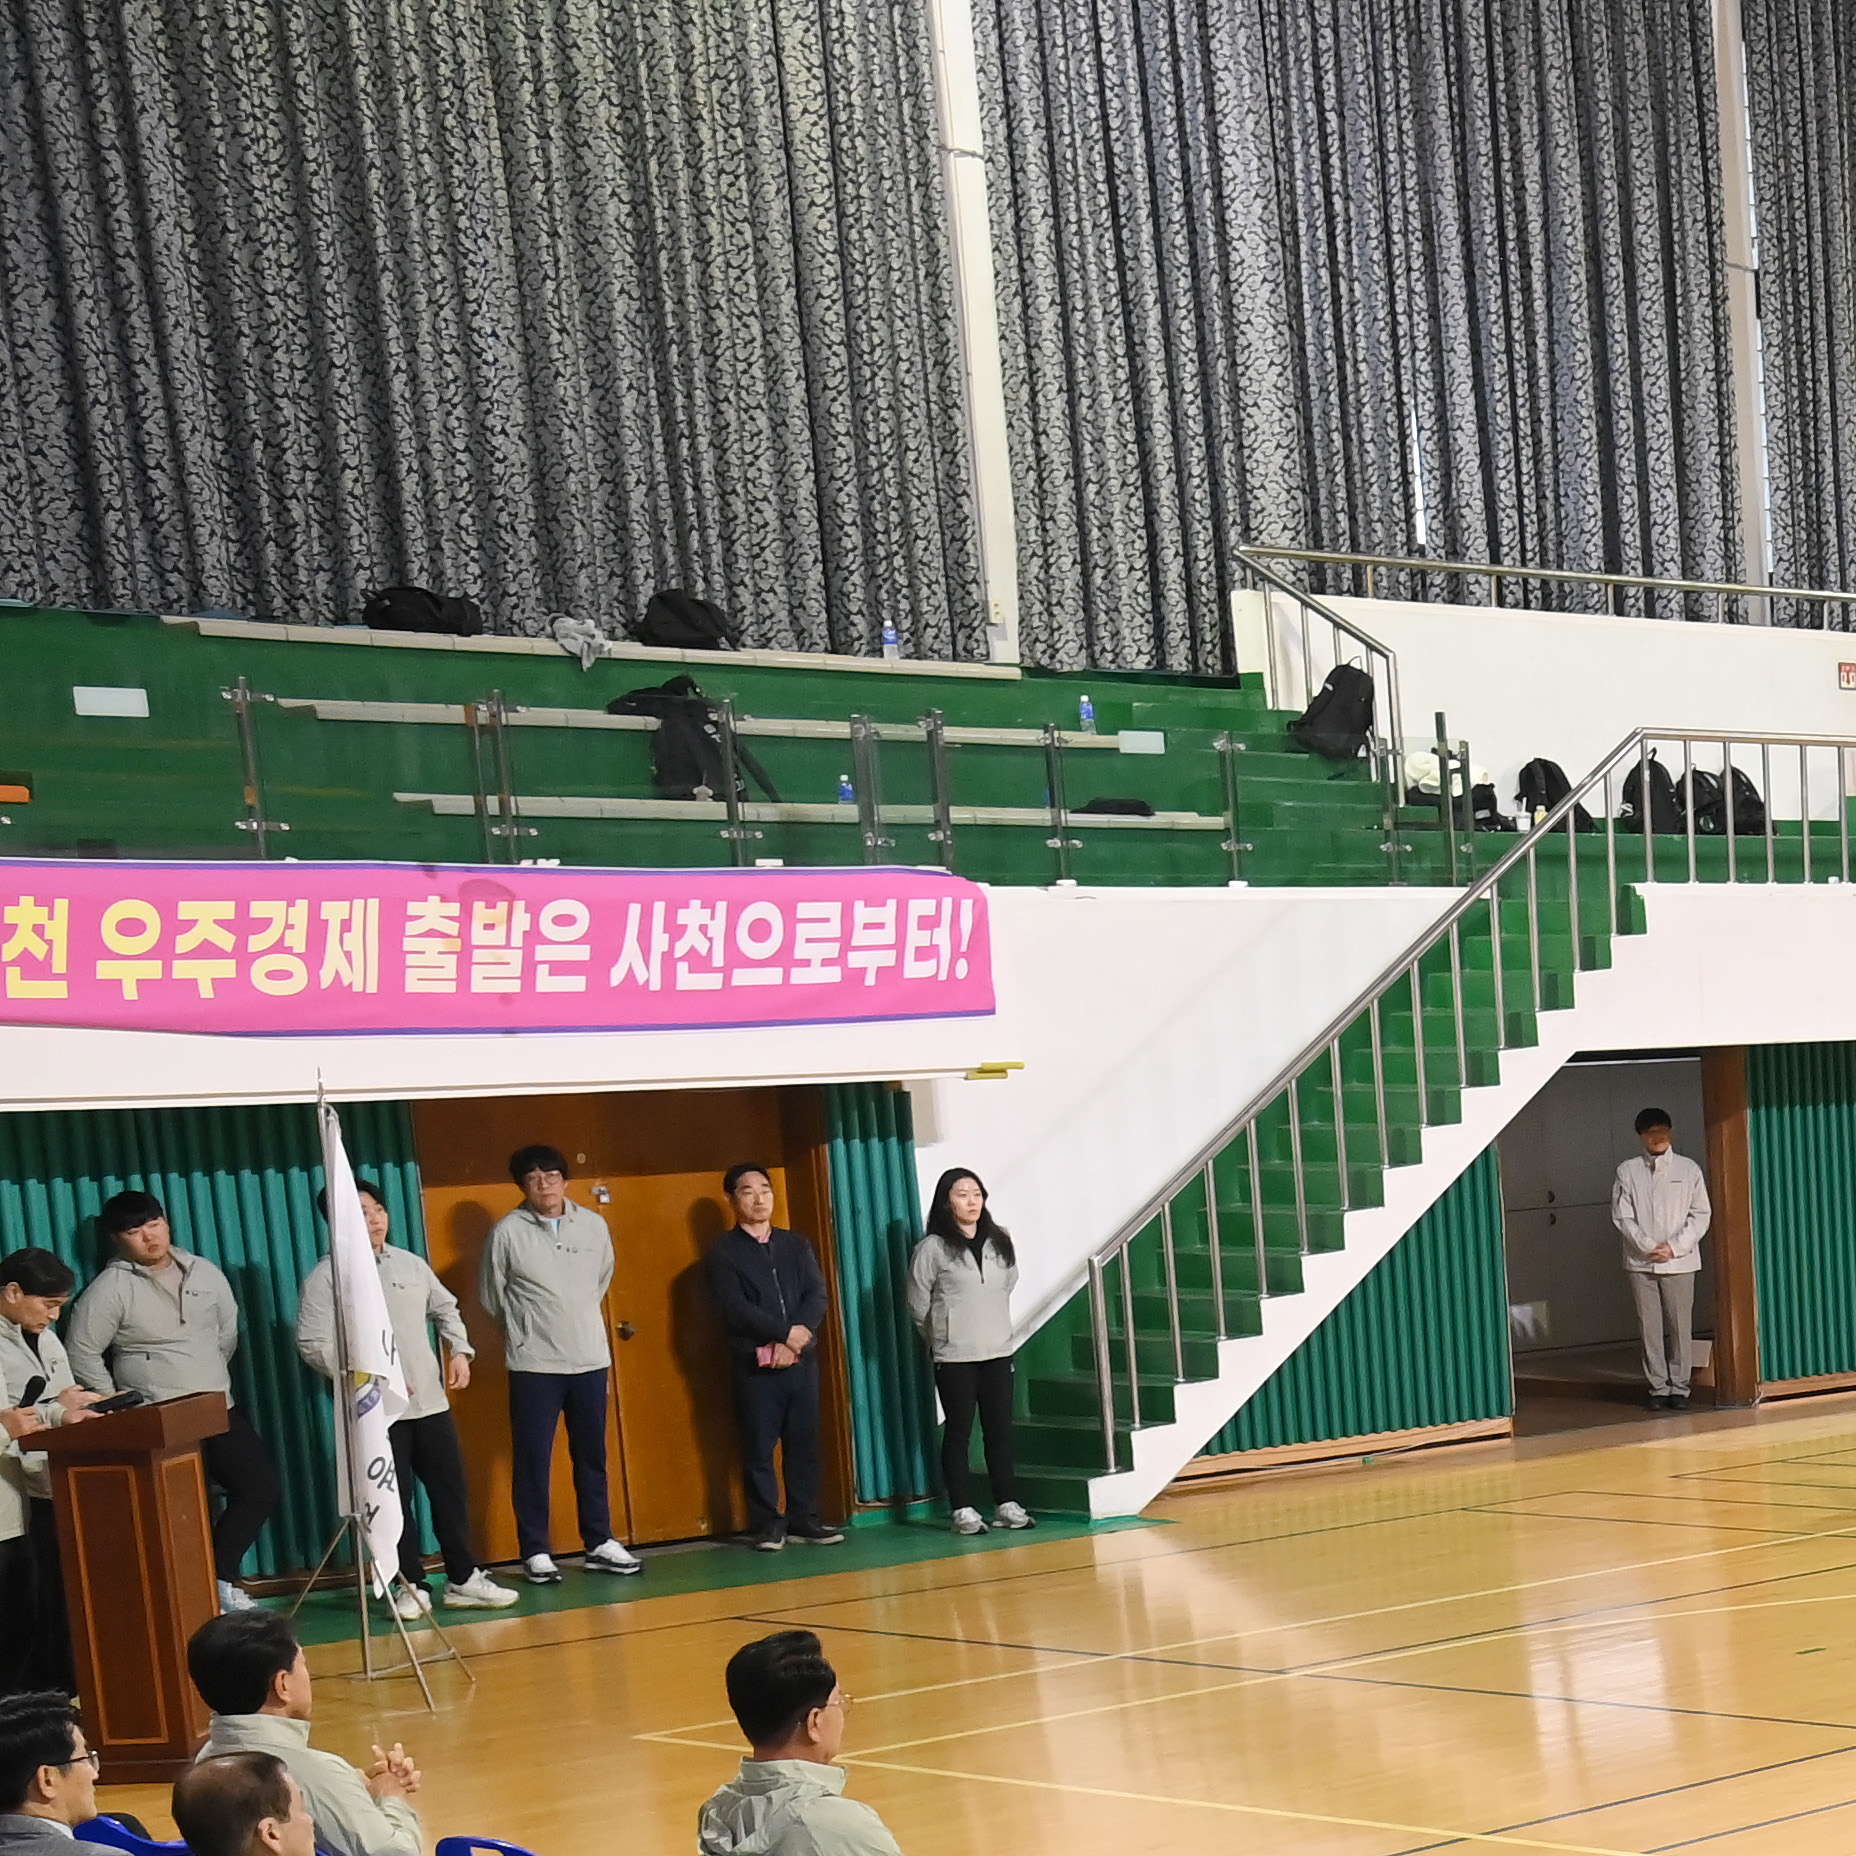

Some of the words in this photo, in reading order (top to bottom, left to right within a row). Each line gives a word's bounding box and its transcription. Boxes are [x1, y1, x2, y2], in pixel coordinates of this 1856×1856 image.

[96, 896, 380, 999] 우주경제
[403, 897, 592, 994] 출발은
[610, 895, 975, 988] 사천으로부터!
